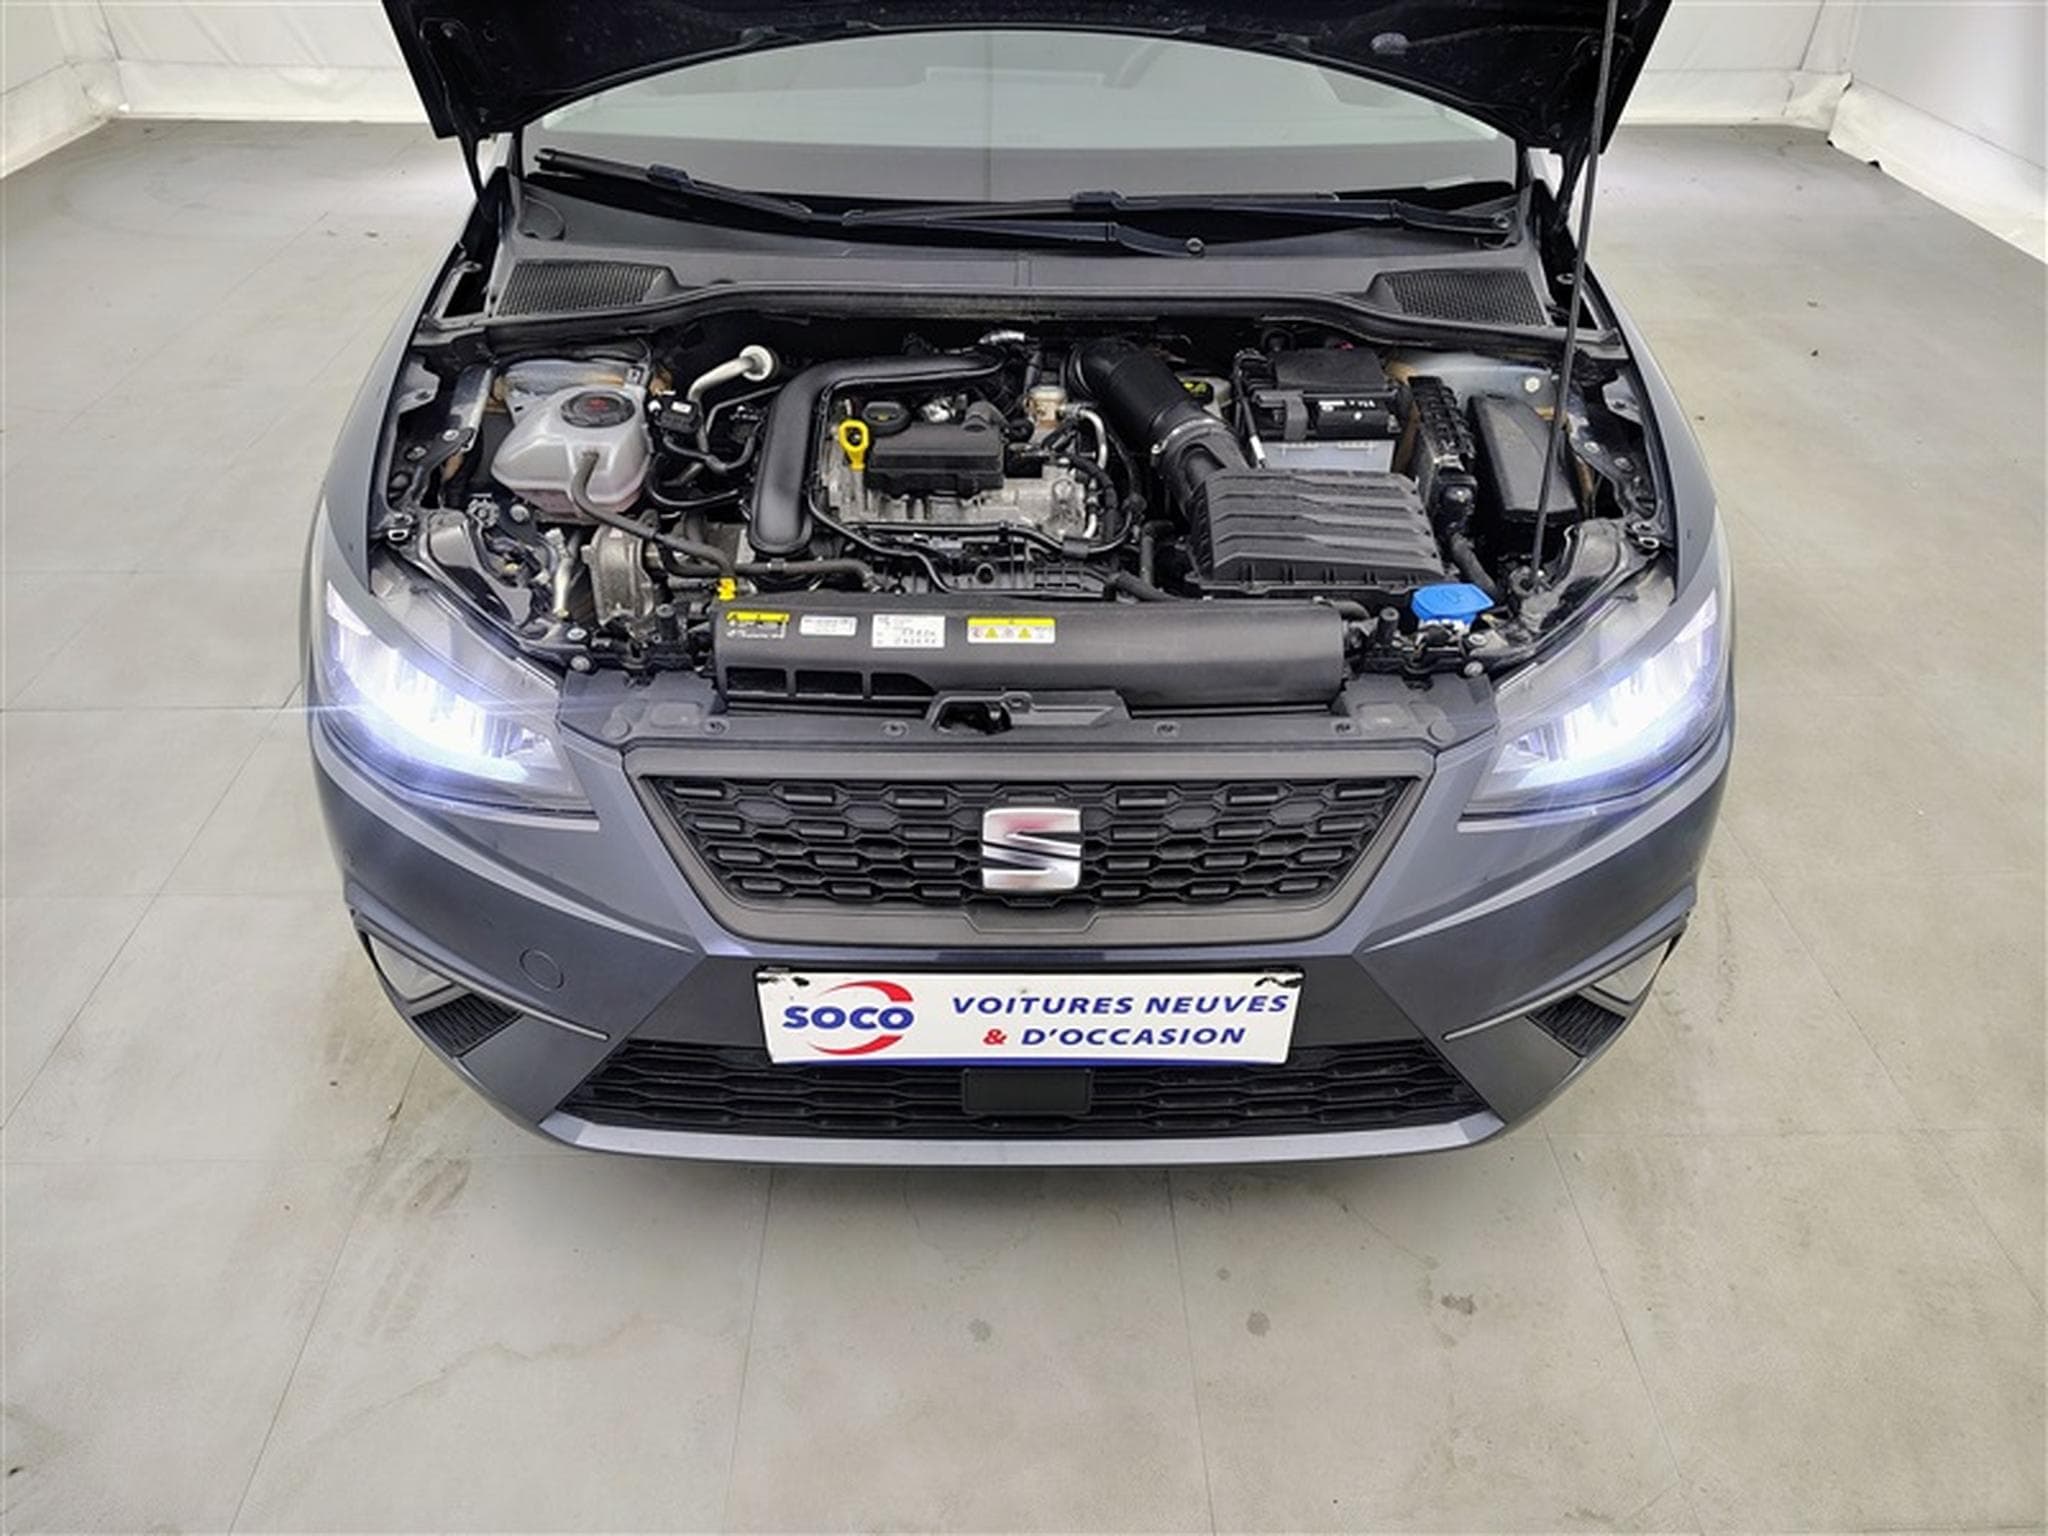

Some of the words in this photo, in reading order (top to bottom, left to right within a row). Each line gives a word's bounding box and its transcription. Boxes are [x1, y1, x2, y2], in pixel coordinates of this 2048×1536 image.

[953, 997, 1133, 1014] VOITURES
[1145, 995, 1288, 1013] NEUVES
[782, 1005, 914, 1031] SOCO
[983, 1029, 1006, 1046] &
[1022, 1027, 1246, 1046] D'OCCASION
